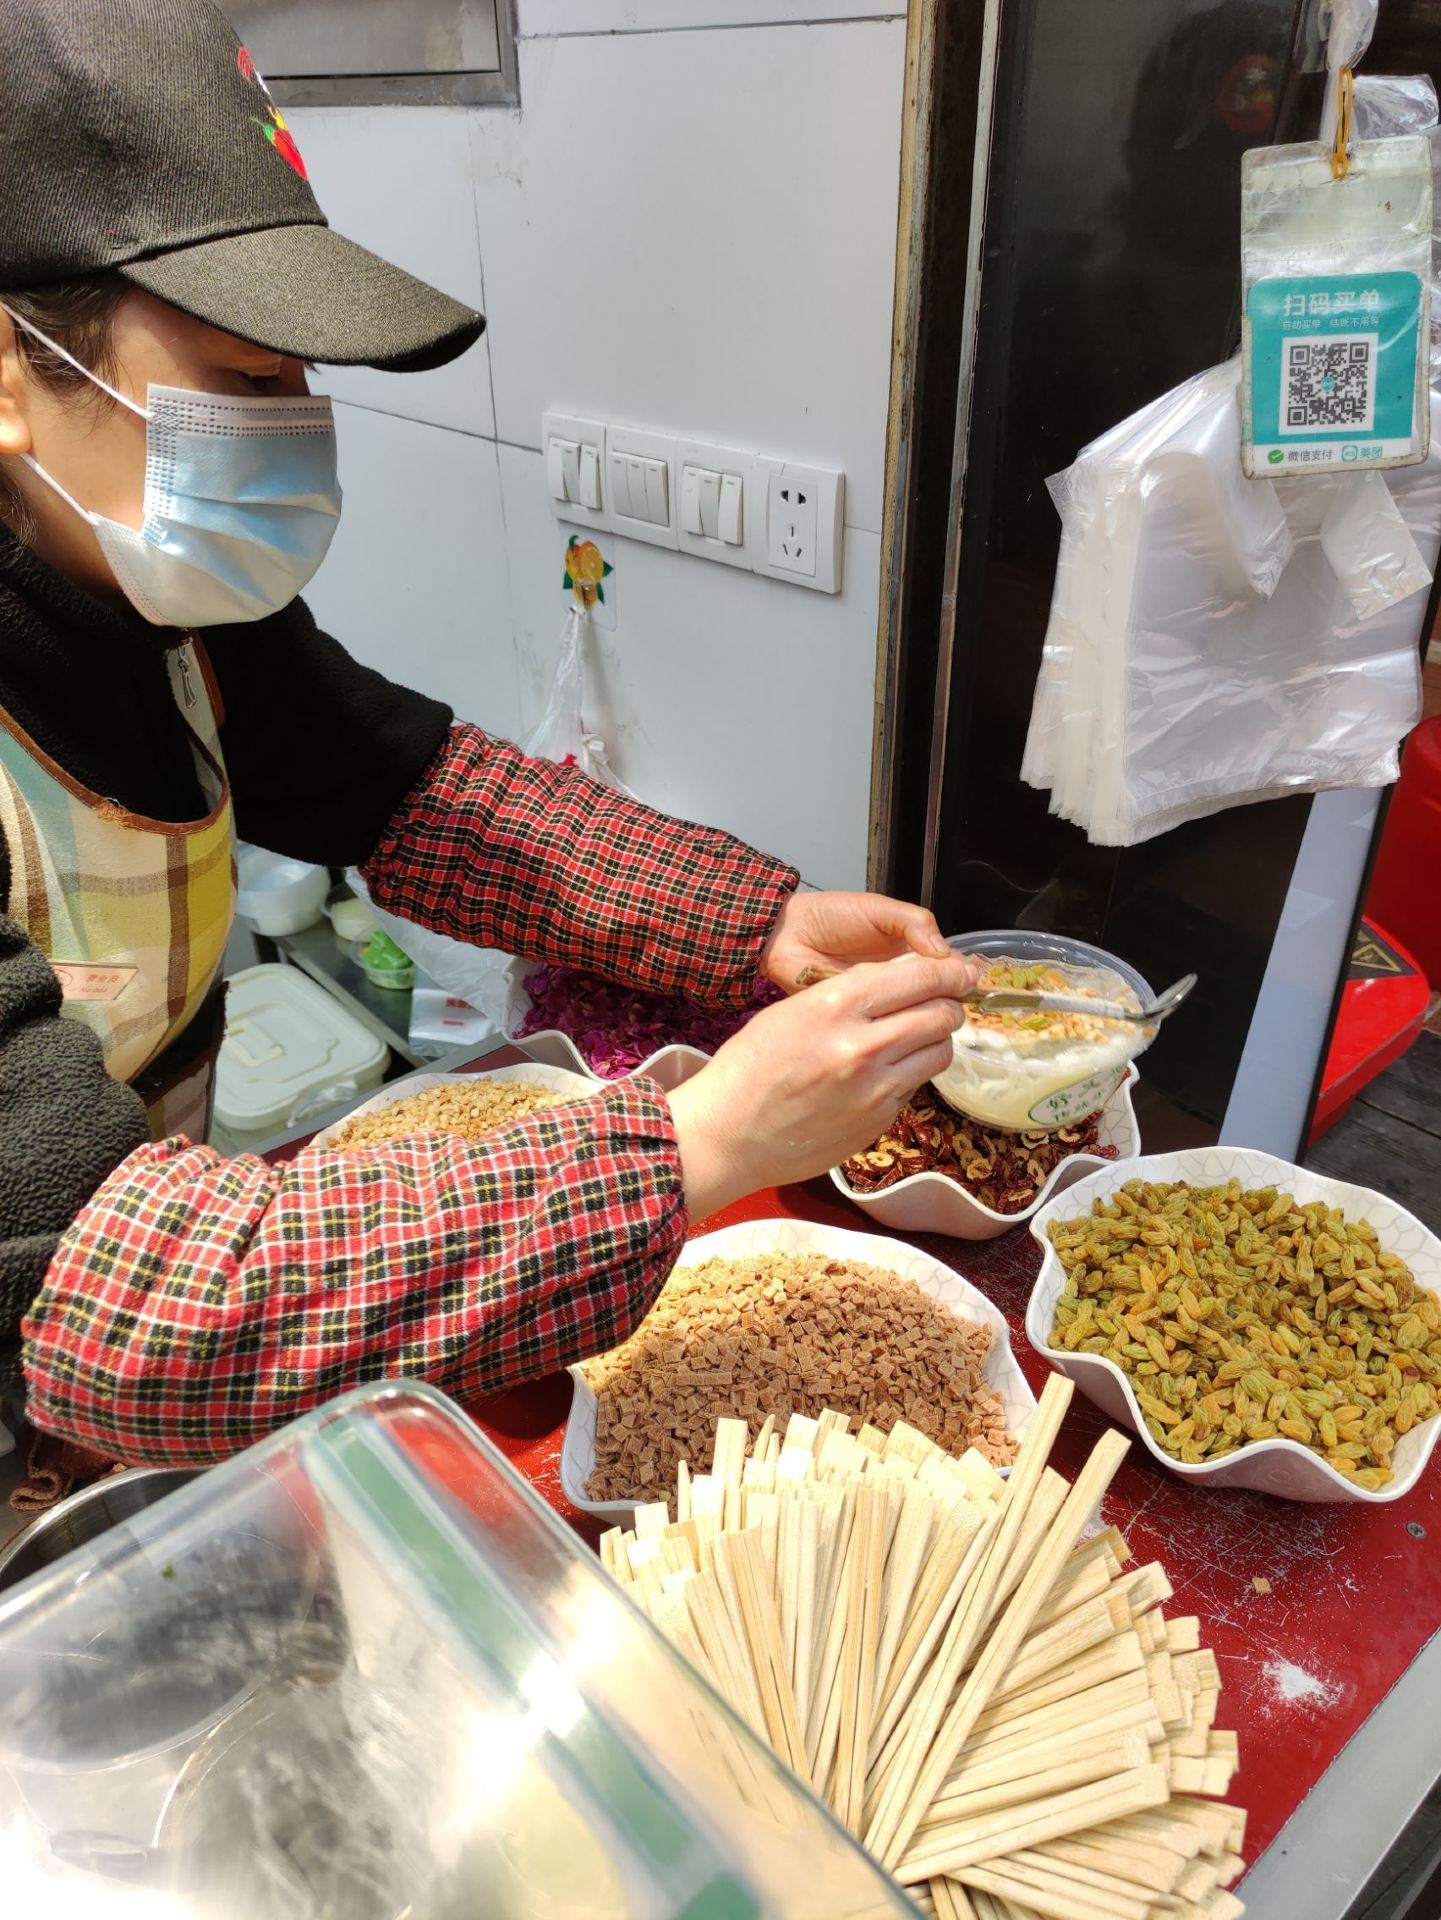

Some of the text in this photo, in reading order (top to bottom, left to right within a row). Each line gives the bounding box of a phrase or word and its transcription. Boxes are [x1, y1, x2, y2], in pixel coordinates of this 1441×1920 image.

[1284, 290, 1380, 316] 扫码买单
[1287, 448, 1333, 462] 微信支付
[1360, 446, 1383, 459] 美团
